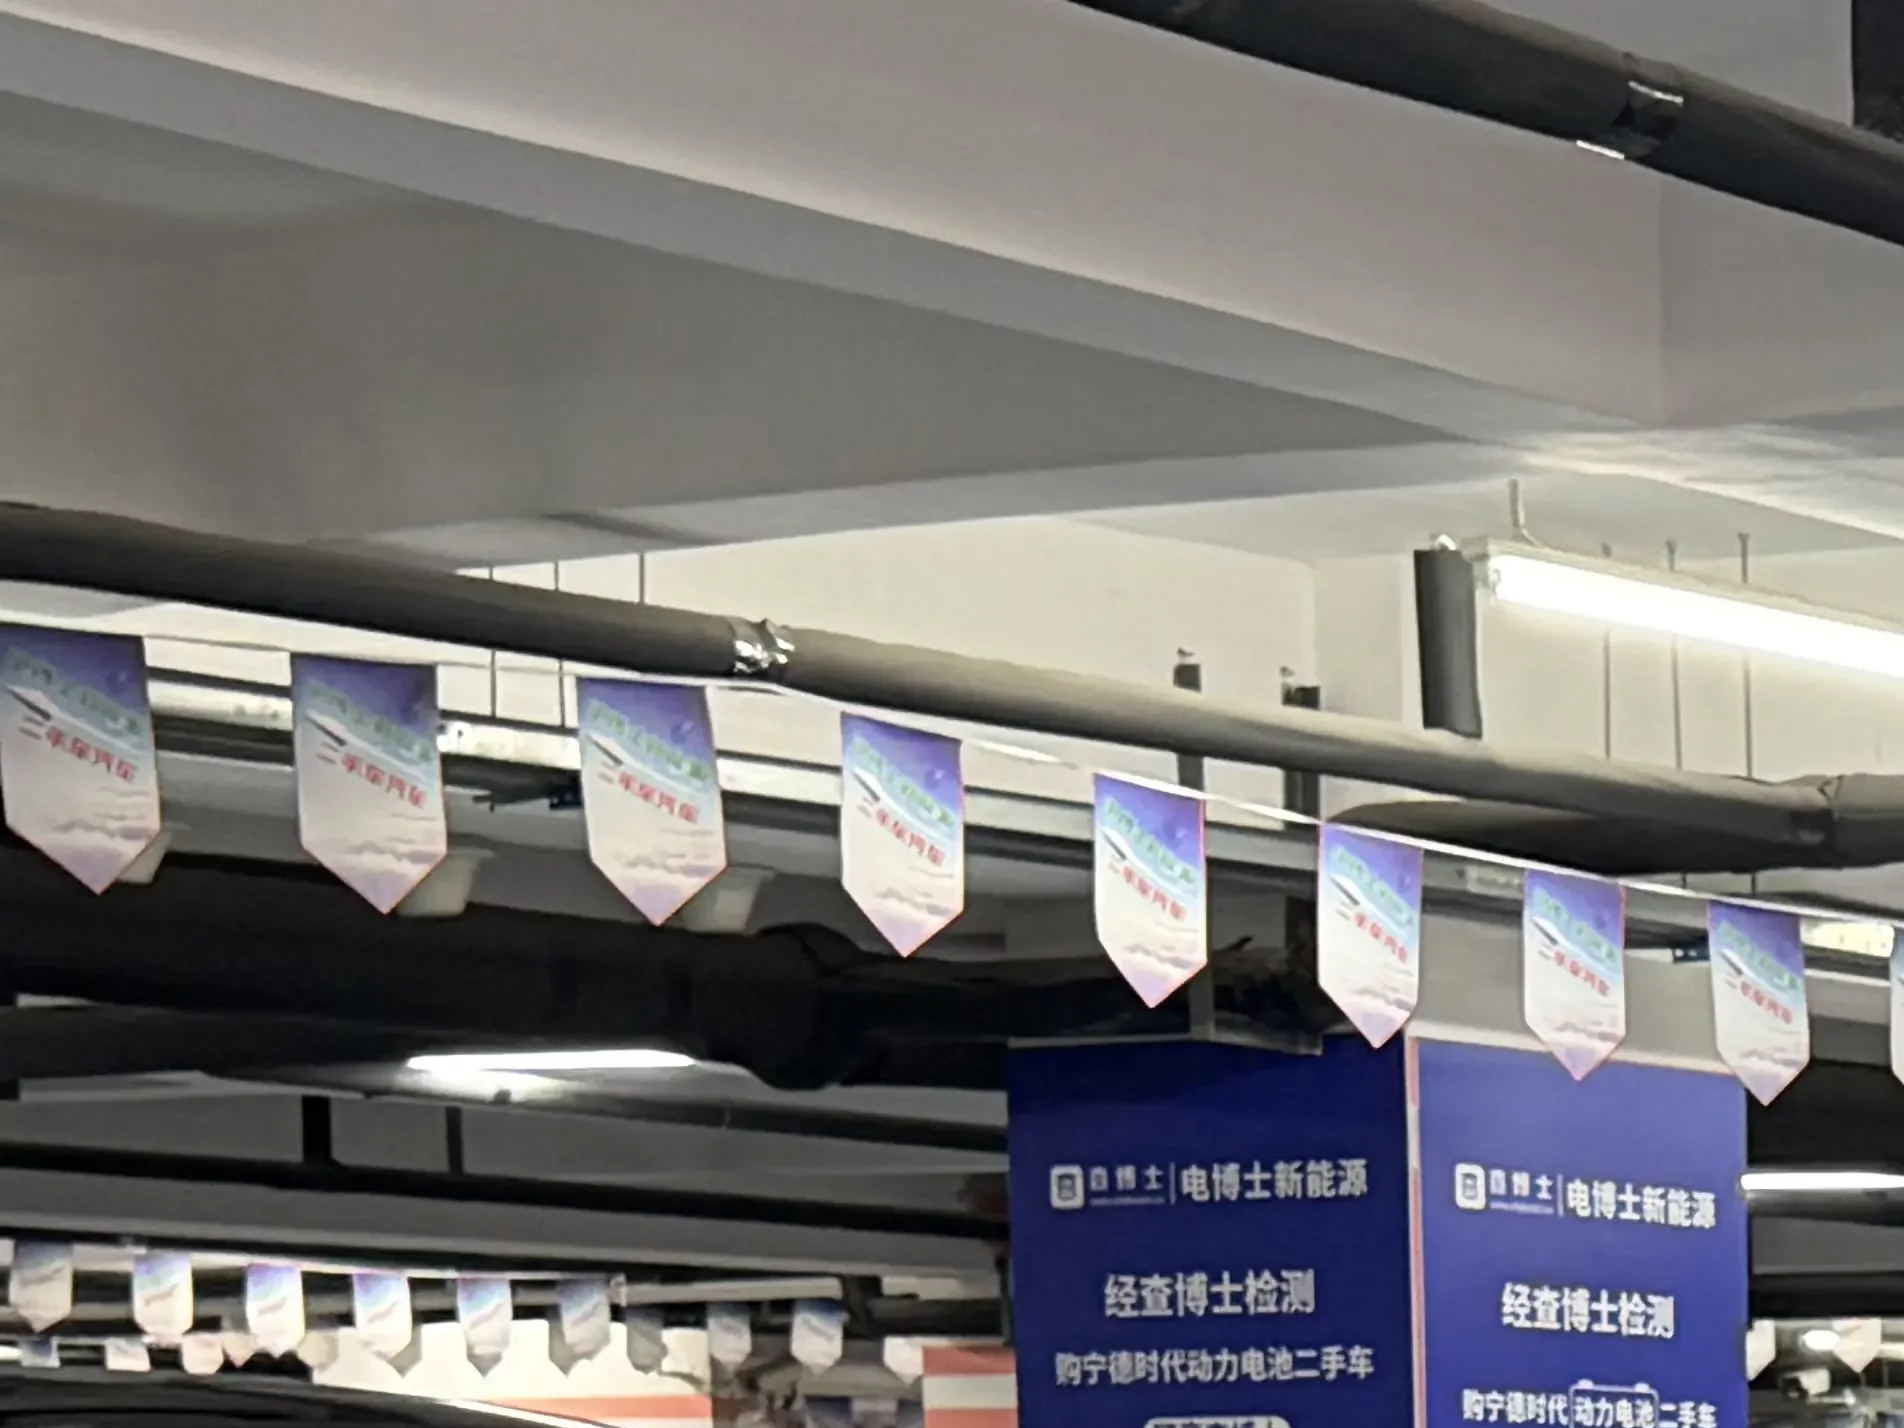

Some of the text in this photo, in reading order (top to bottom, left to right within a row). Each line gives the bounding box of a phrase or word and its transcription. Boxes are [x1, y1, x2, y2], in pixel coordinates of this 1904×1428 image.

[1181, 1158, 1369, 1202] 电博士新能源
[1566, 1178, 1716, 1230] 电博士新能源
[1104, 1268, 1316, 1318] 经查博士检测
[1501, 1281, 1675, 1340] 经查博士检测
[1055, 1345, 1375, 1386] 购宁德时代动力电池二手车
